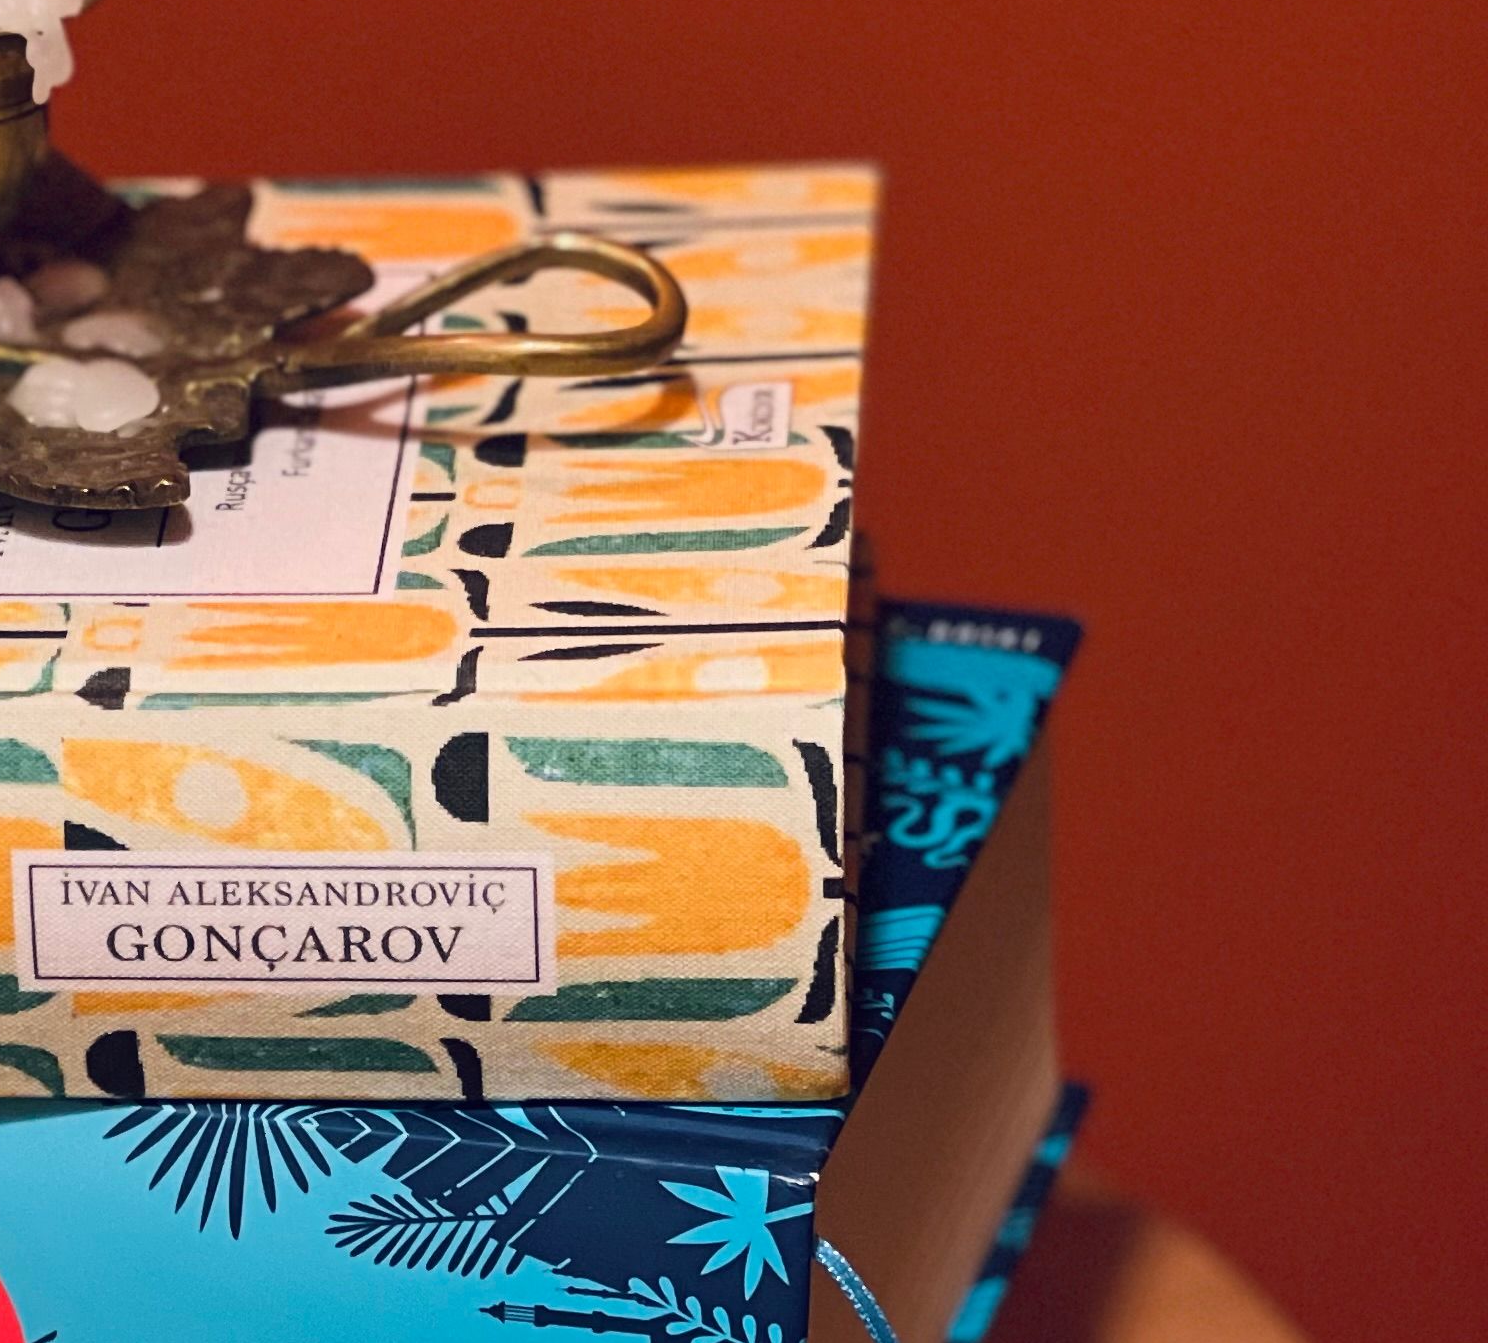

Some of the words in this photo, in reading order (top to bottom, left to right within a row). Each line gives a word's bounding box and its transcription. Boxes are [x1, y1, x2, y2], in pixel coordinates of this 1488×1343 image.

[215, 471, 256, 511] Rusça
[61, 872, 150, 906] İVAN
[168, 873, 506, 914] ALEKSANDROVİÇ
[106, 924, 463, 972] GONÇAROV
